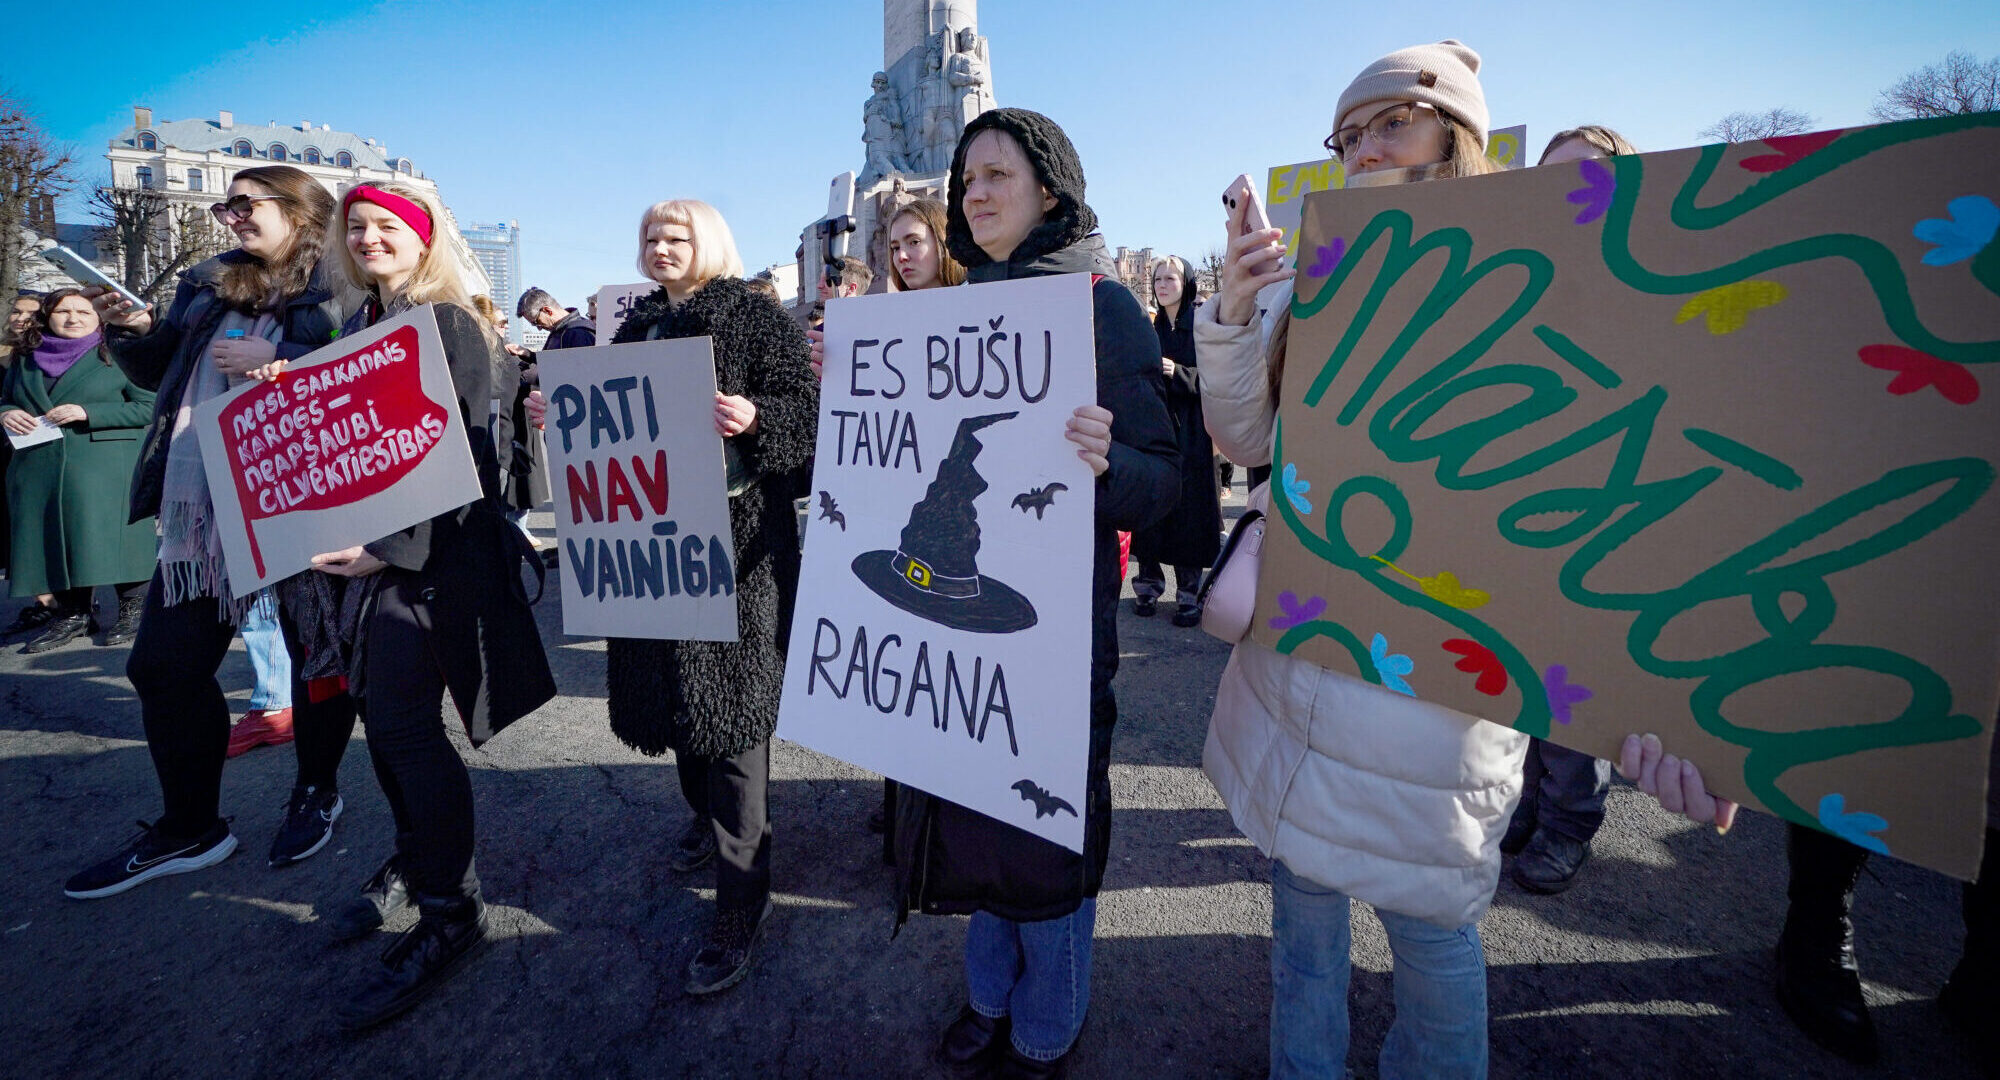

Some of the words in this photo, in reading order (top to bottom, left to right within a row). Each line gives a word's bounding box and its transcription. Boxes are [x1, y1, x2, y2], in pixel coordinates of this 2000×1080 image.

[850, 338, 904, 400] ES
[926, 315, 1052, 404] BŪŠU
[237, 396, 325, 467] KAROGS
[551, 375, 659, 454] PATI
[831, 410, 921, 473] TAVA
[566, 449, 669, 525] NAV
[566, 520, 735, 602] VAINĪGA
[808, 617, 1018, 756] RAGANA
